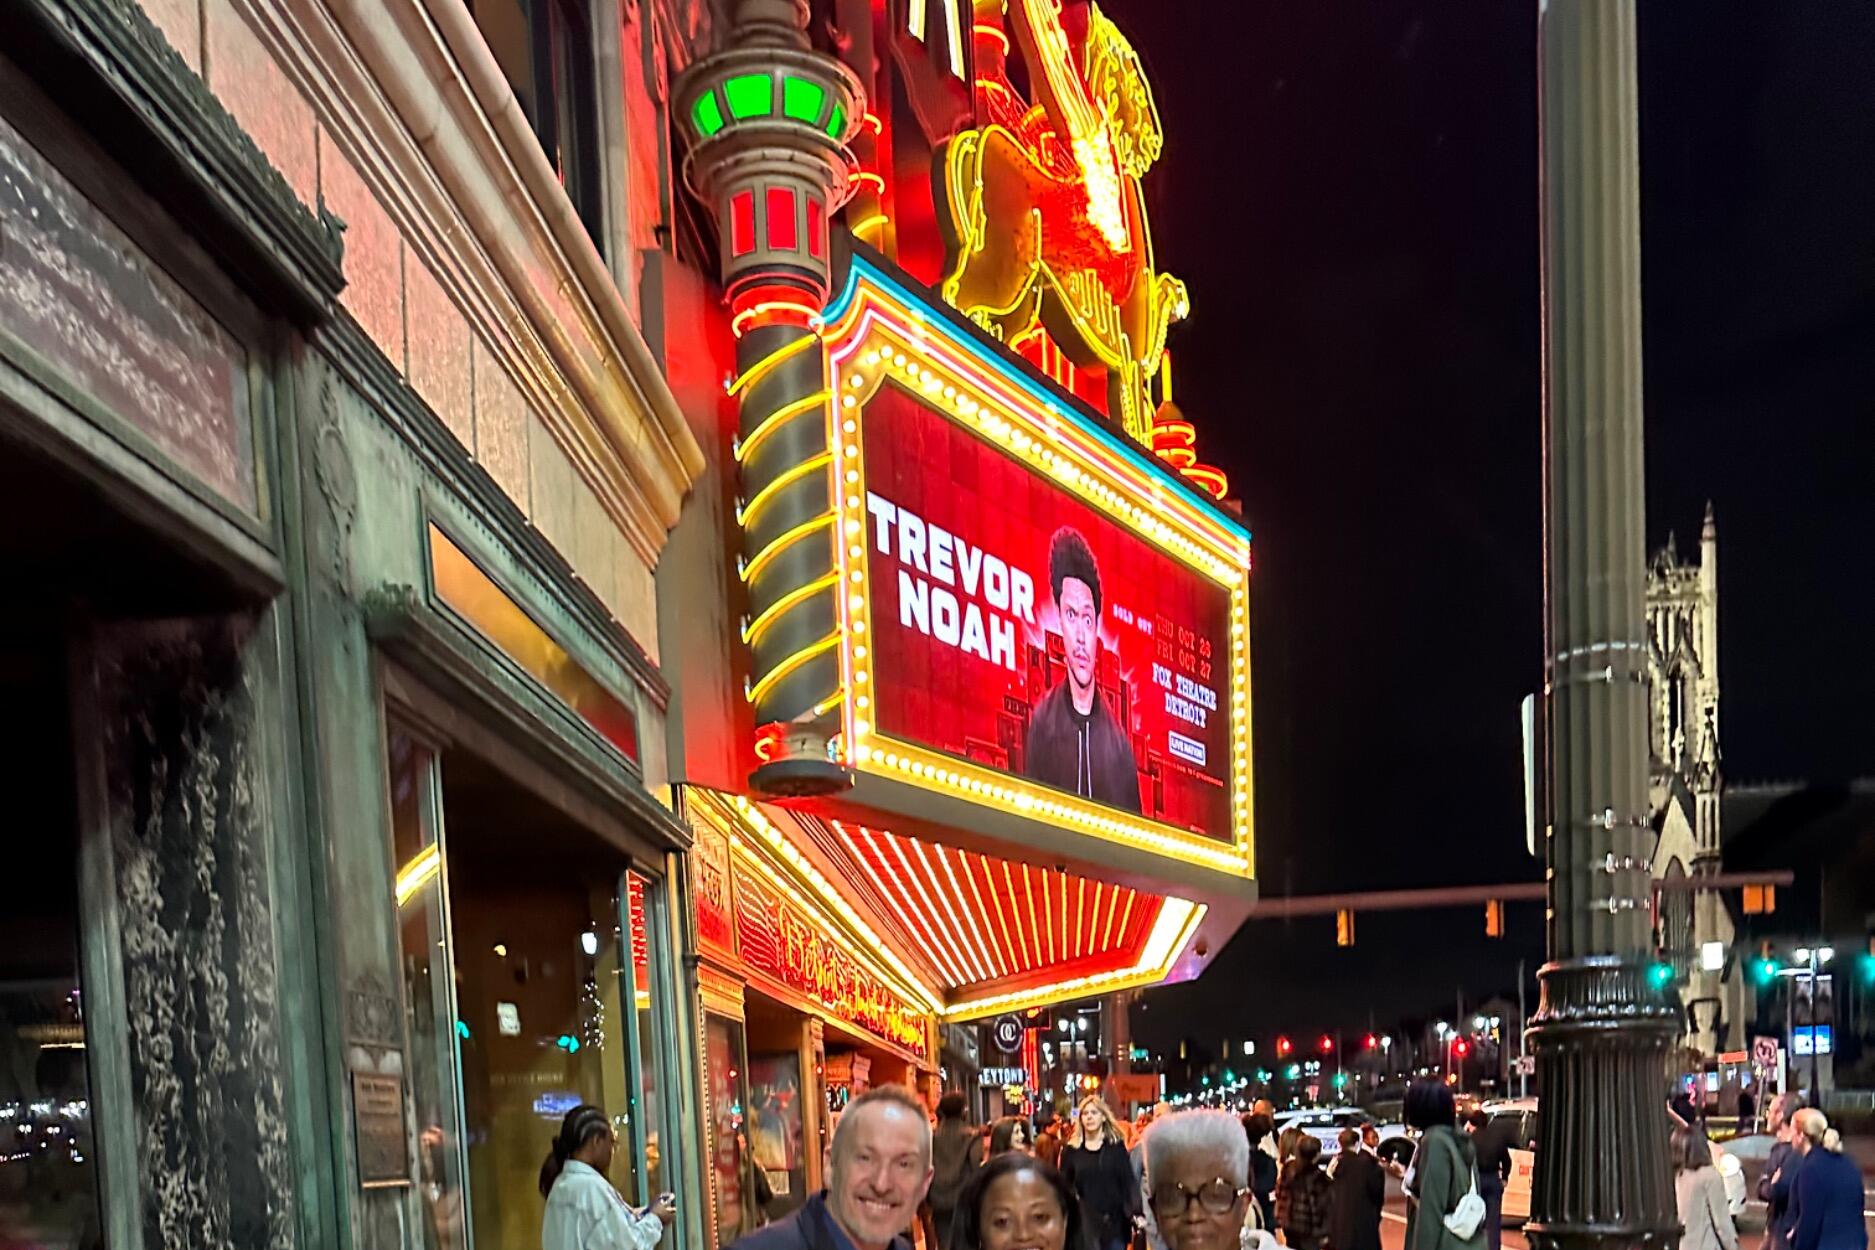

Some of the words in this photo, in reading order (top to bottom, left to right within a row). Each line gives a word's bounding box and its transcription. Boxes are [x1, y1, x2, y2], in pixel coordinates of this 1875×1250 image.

[867, 491, 1035, 624] TREVOR
[898, 569, 1016, 672] NOAH
[1178, 626, 1195, 651] OCT
[1179, 649, 1196, 673] OCT
[1200, 660, 1211, 680] 27
[1152, 662, 1172, 690] FOX
[1176, 672, 1217, 712] THEATRE
[1164, 692, 1206, 729] DETROIT
